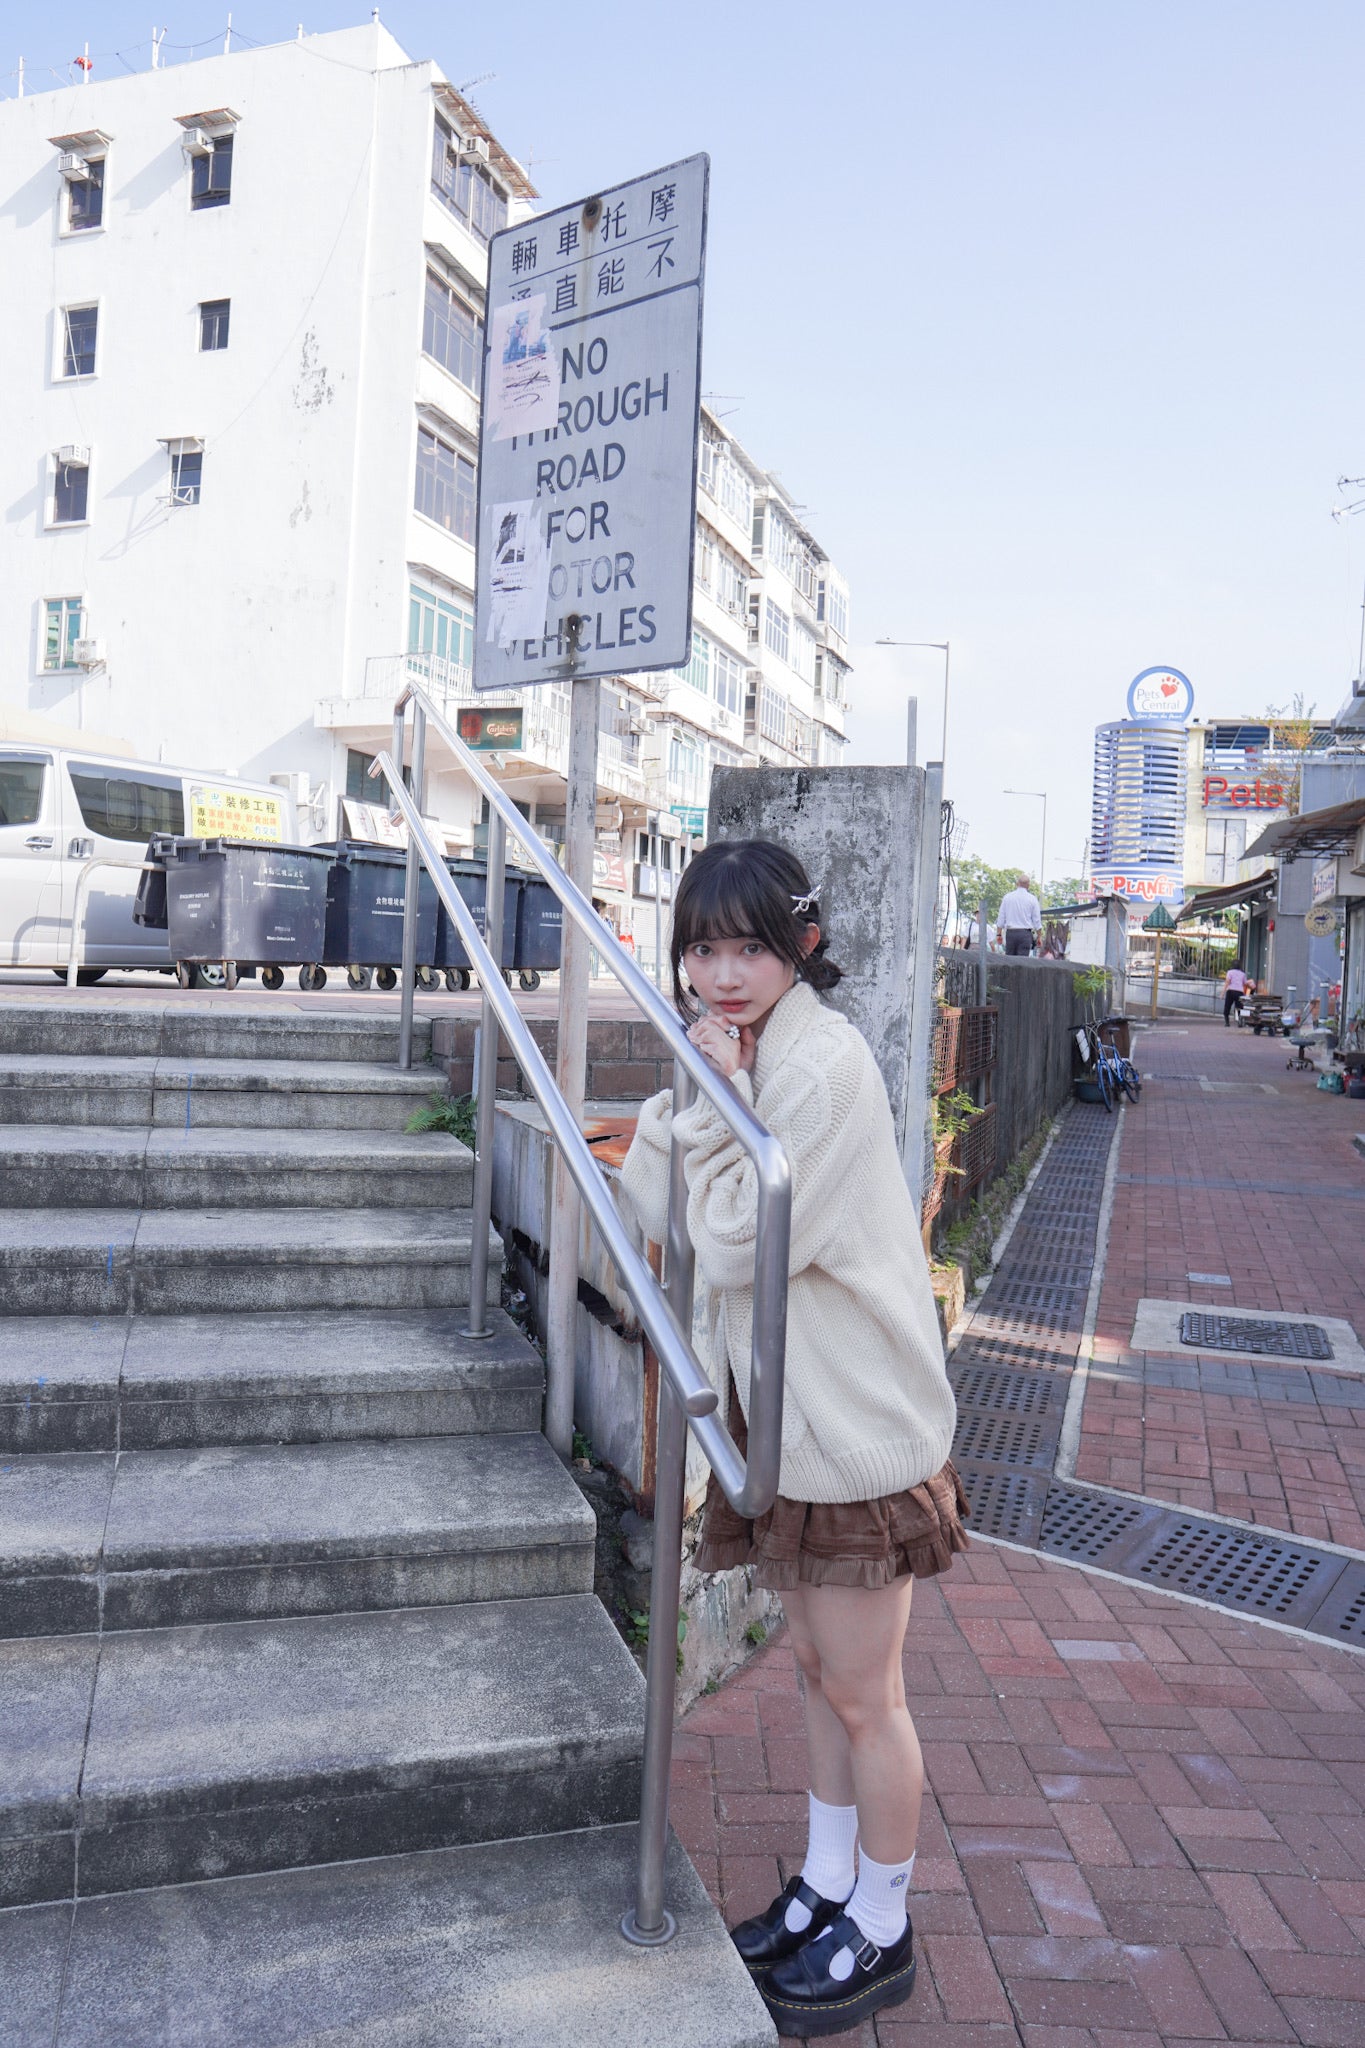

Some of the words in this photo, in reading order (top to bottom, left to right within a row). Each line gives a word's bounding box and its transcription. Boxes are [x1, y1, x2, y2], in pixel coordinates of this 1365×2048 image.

[561, 337, 608, 384] NO
[536, 442, 626, 498] ROAD
[546, 500, 611, 549] FOR
[549, 551, 637, 602] OTOR
[1141, 699, 1180, 711] Central
[486, 722, 517, 737] Carlsberg
[1203, 776, 1284, 808] Pets
[1113, 876, 1175, 900] PLANET
